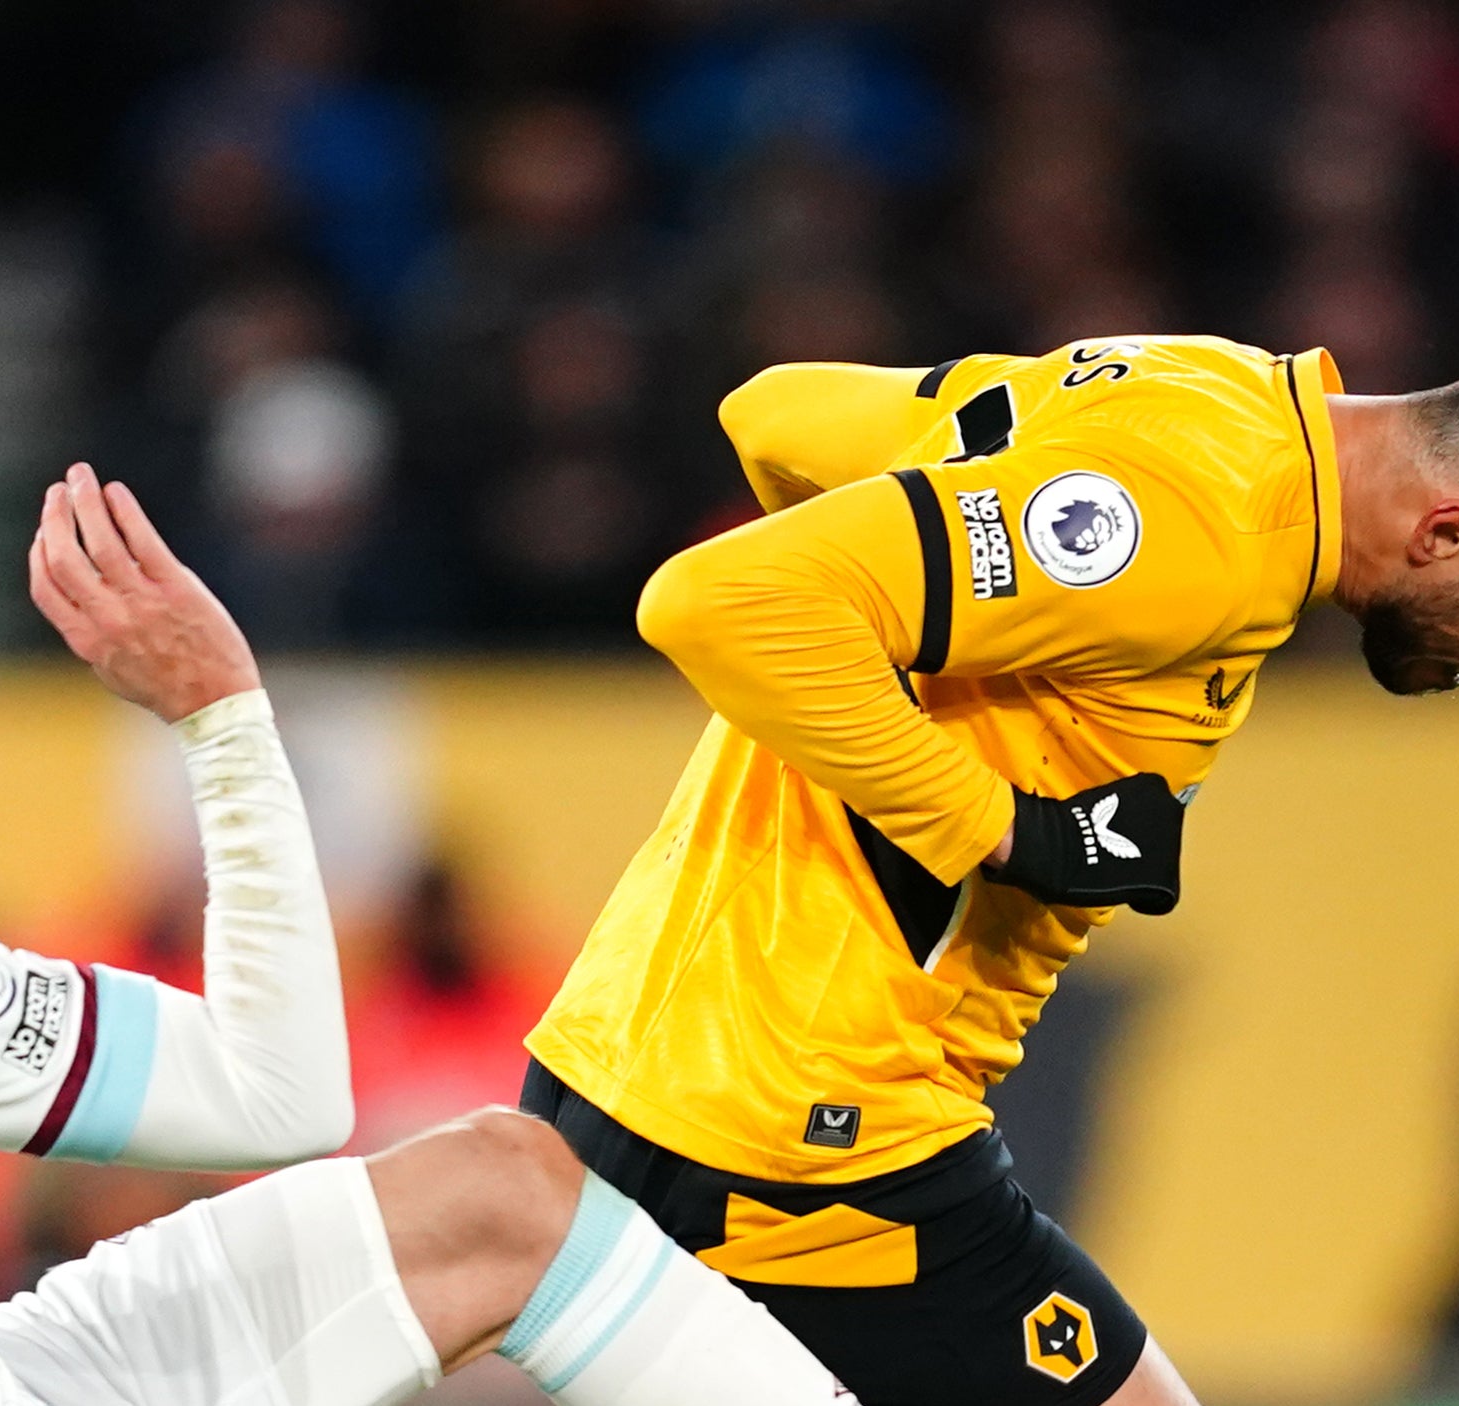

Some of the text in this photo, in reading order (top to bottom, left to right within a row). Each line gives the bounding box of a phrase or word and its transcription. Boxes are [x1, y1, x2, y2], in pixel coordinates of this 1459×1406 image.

[955, 490, 994, 601] for racism
[975, 487, 1014, 588] No room
